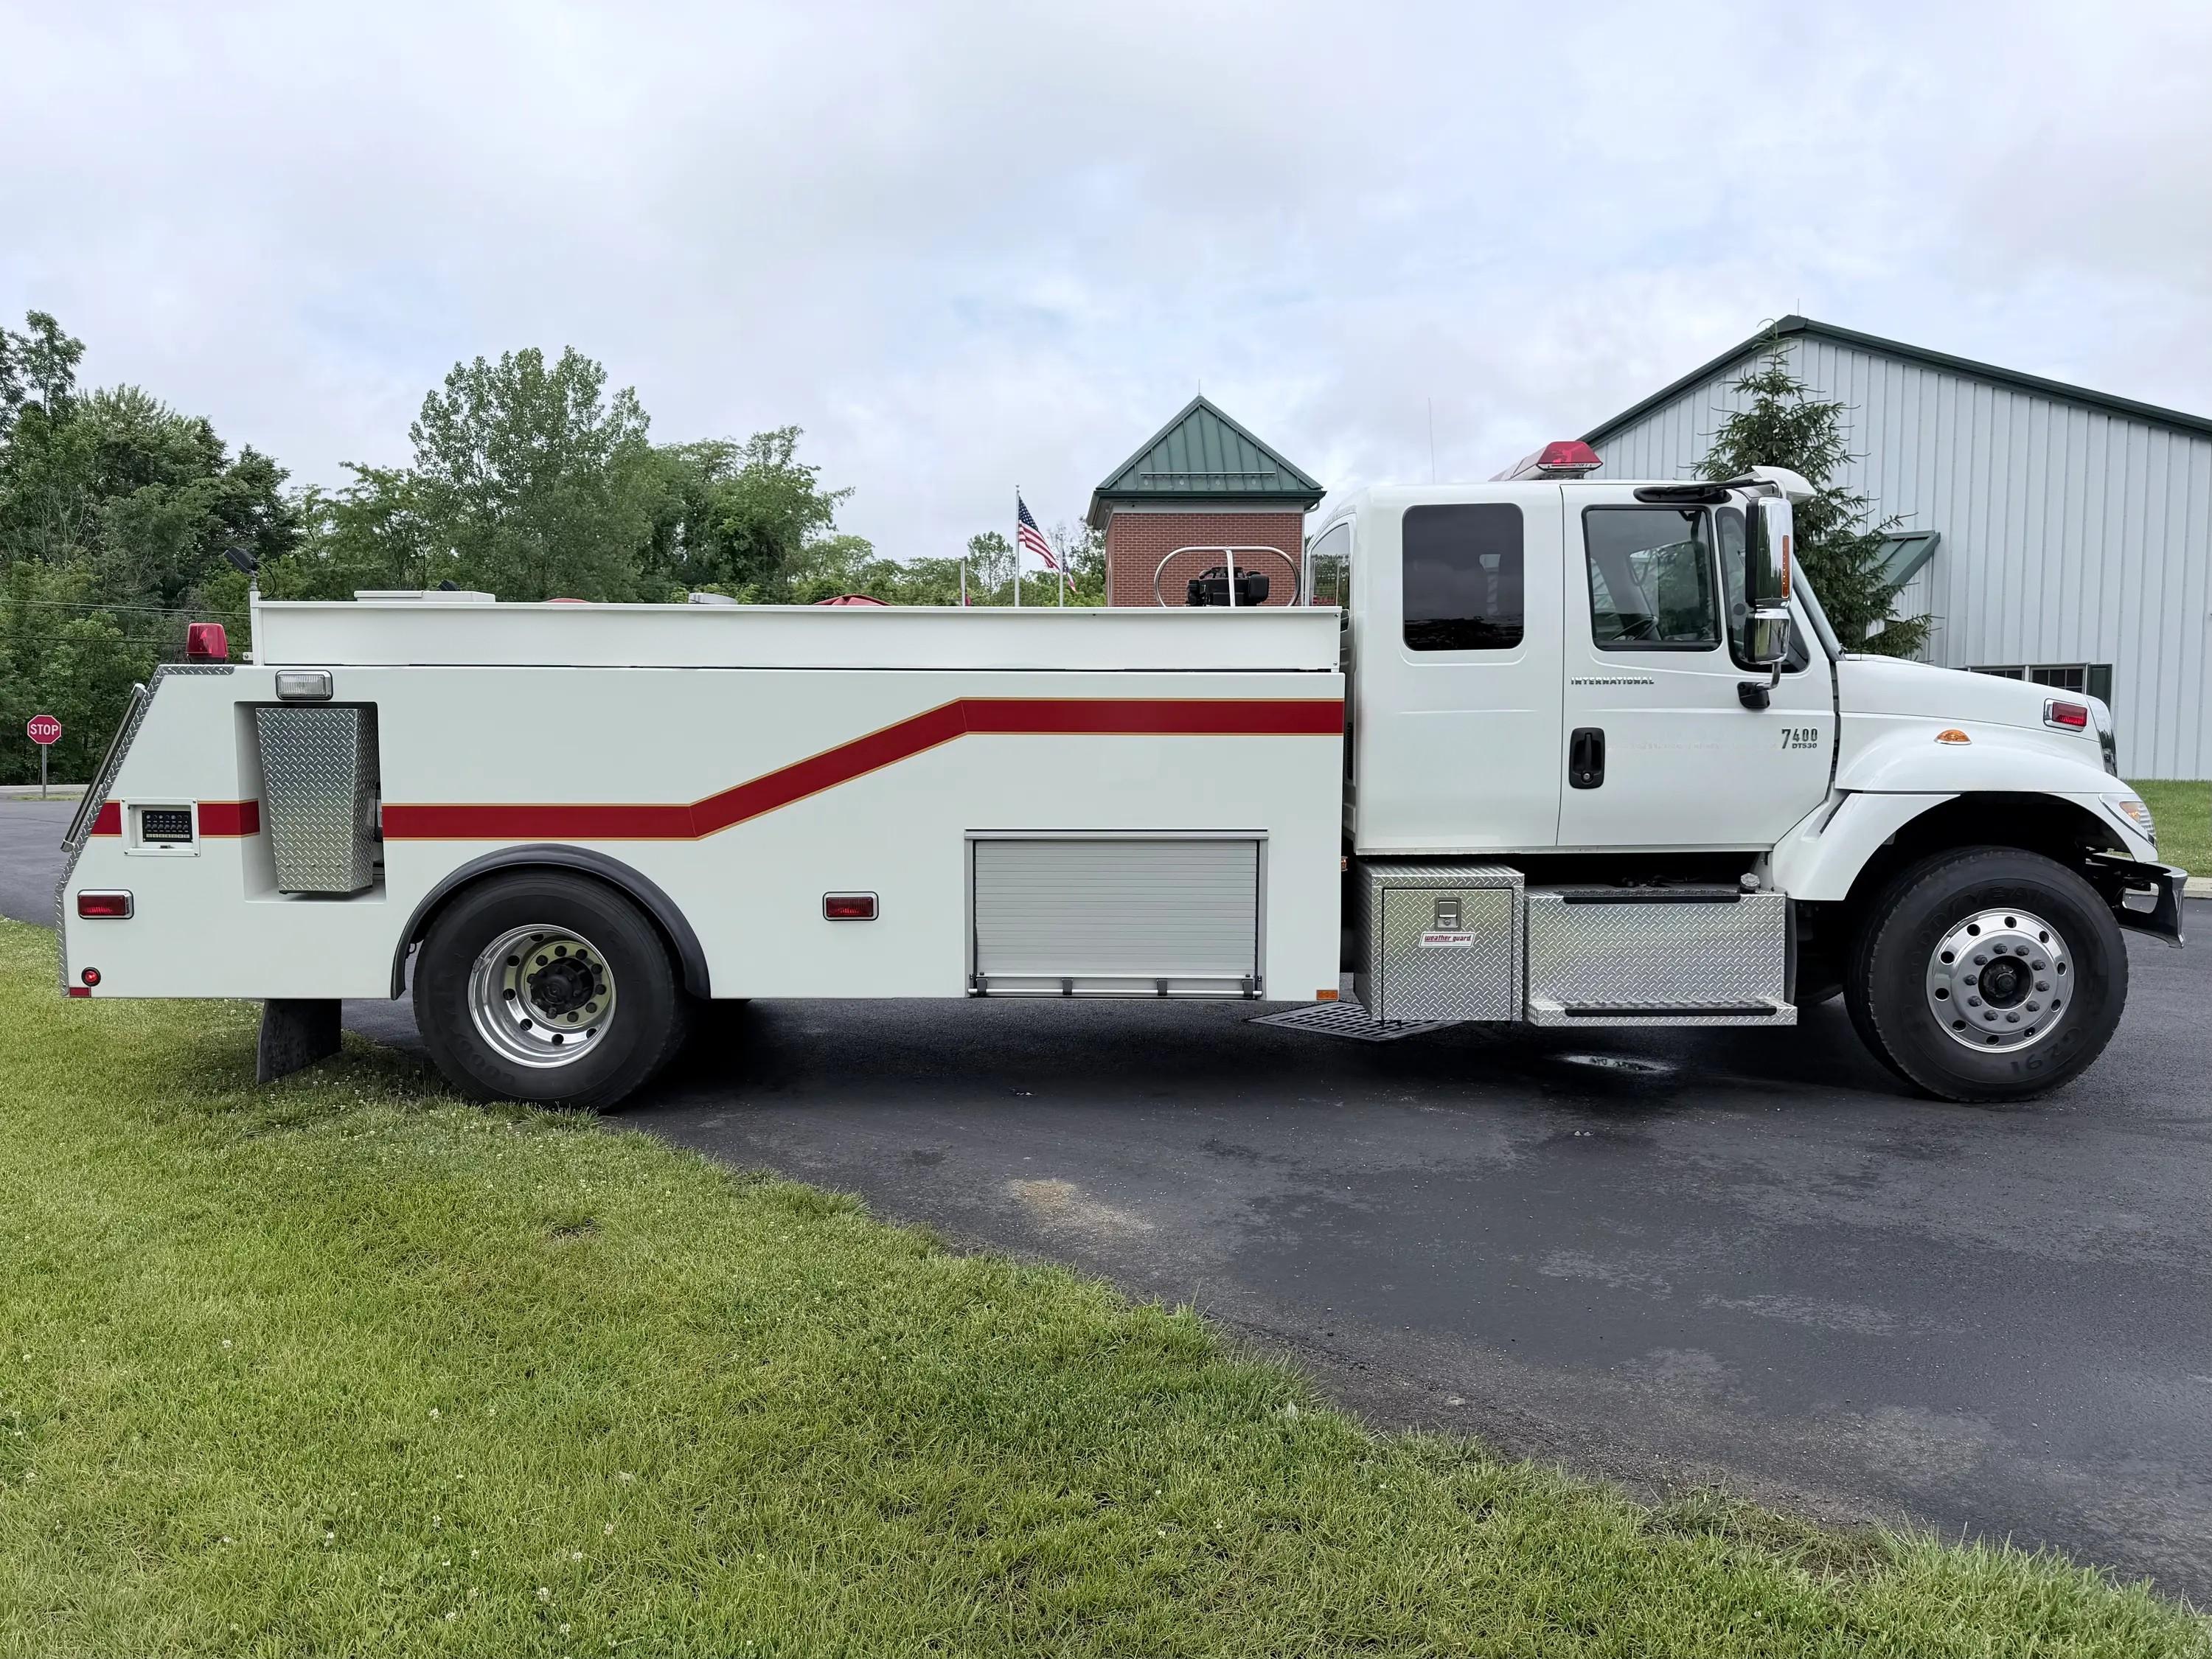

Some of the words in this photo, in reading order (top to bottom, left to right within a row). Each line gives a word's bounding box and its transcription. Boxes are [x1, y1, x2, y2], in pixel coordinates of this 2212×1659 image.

[1571, 676, 1655, 685] INTERNATIONAL
[30, 724, 58, 735] STOP
[1781, 728, 1818, 749] 7400
